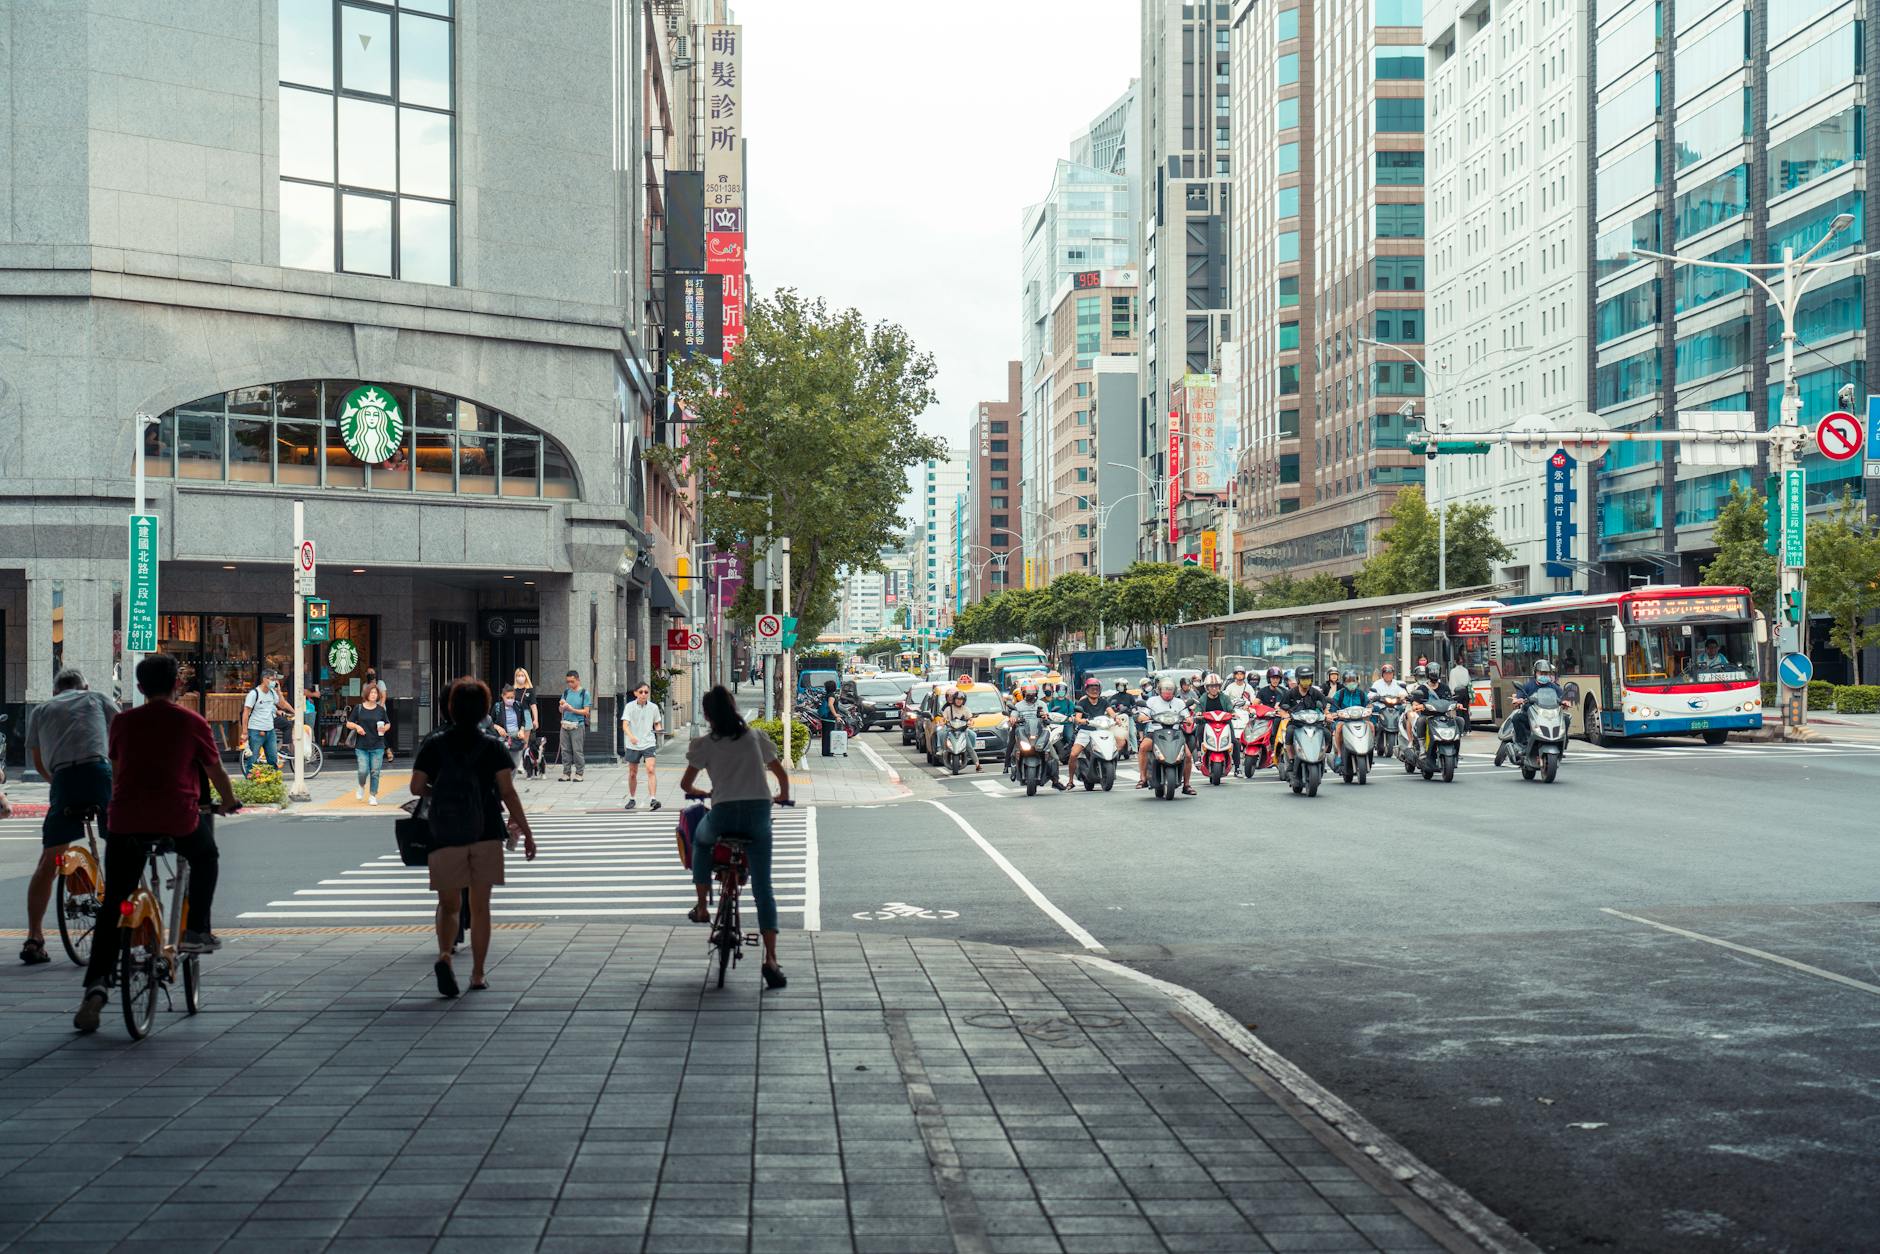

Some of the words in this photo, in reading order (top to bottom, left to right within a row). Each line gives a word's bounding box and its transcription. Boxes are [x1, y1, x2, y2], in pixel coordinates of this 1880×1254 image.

[710, 29, 737, 152] 萌髮診所
[714, 194, 733, 205] 8F
[1553, 470, 1564, 517] 永豐銀行
[1790, 478, 1799, 528] 南京東路三段
[137, 526, 150, 600] 建國北路二段
